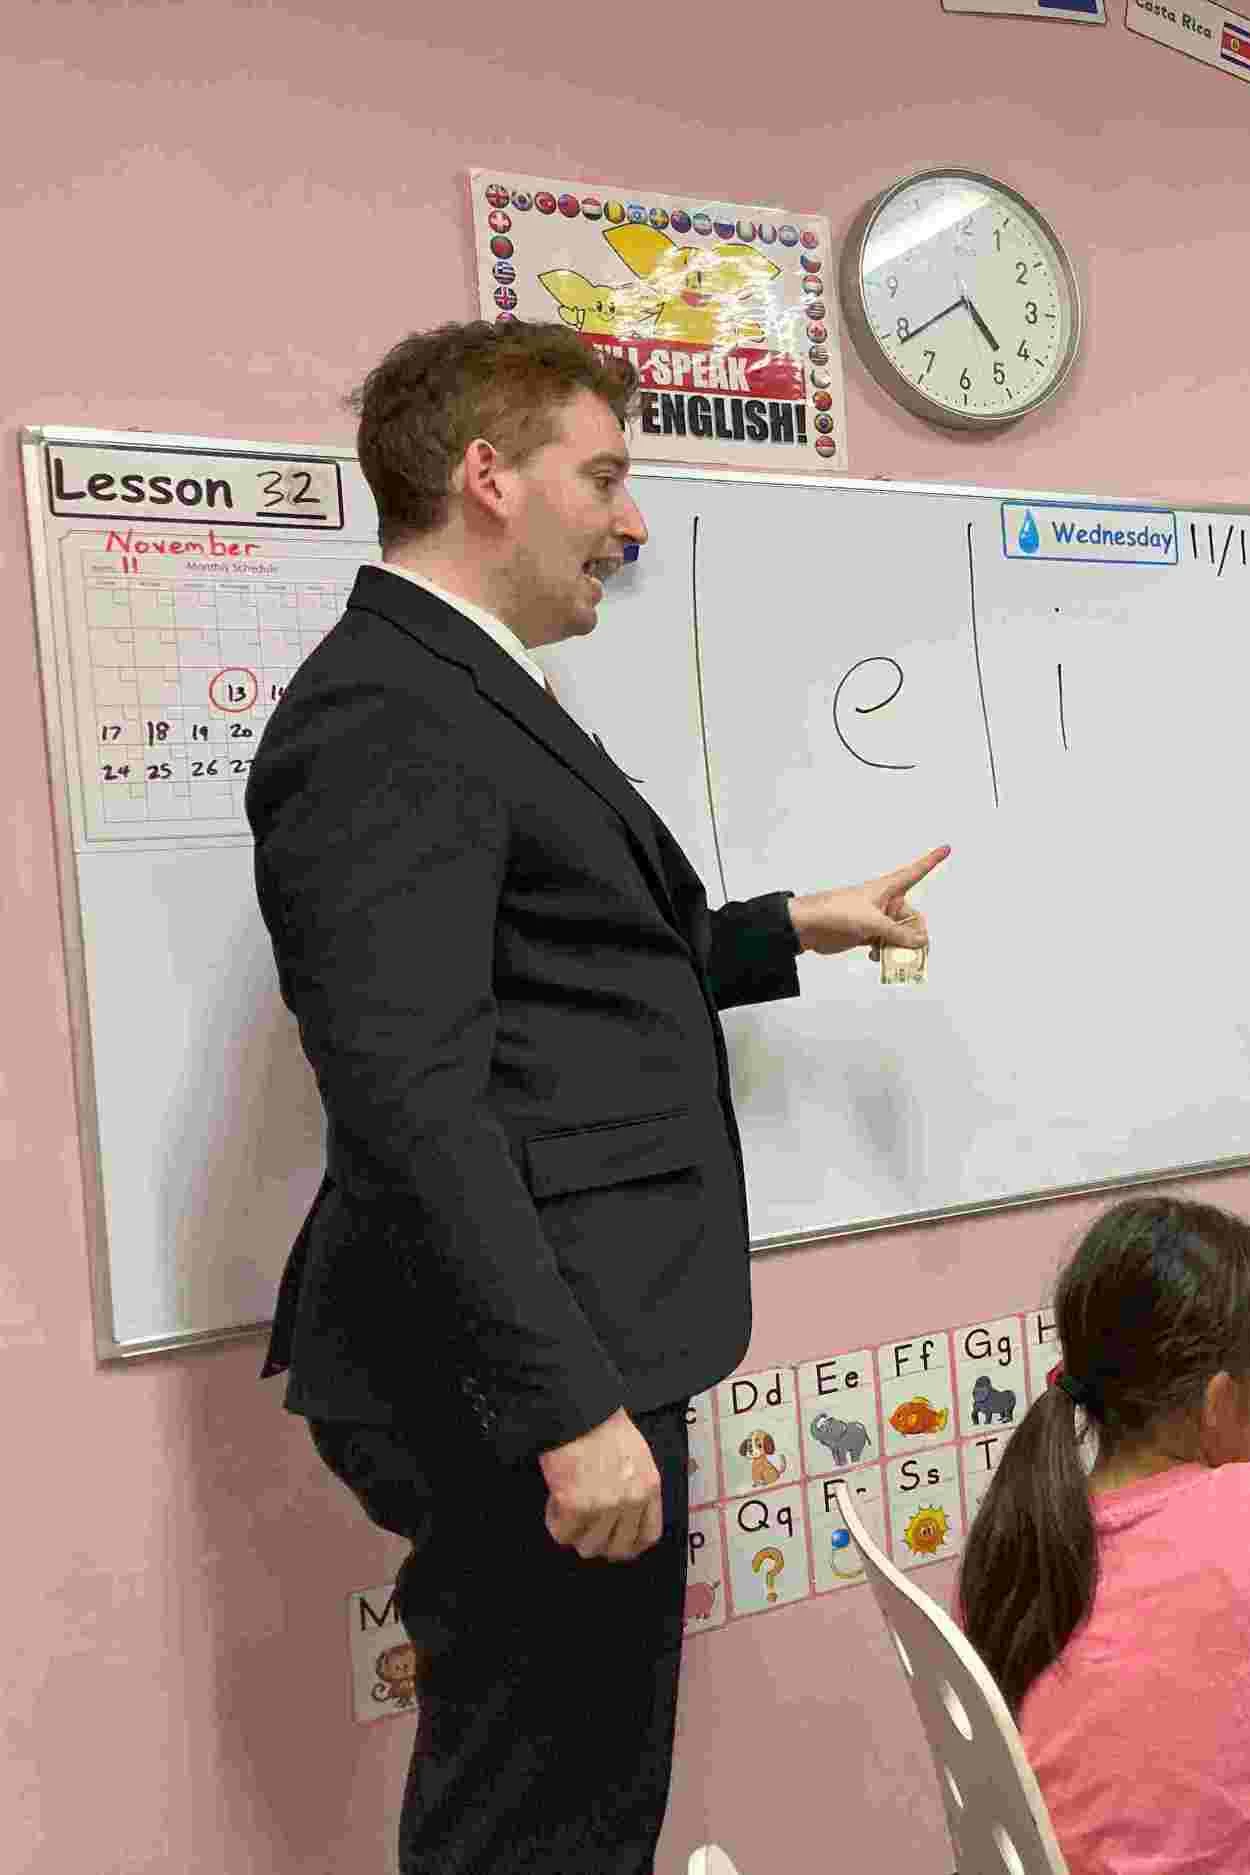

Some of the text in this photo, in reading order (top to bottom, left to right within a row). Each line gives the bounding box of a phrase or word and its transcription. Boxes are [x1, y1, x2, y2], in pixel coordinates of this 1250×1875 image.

[1182, 12, 1212, 39] Rica
[992, 228, 1001, 252] 1
[886, 274, 899, 298] 9
[1015, 261, 1028, 286] 2
[1024, 301, 1038, 325] 3
[896, 317, 911, 340] 8
[923, 350, 936, 374] 7
[1016, 339, 1030, 361] 4
[652, 348, 752, 392] SPEAK
[959, 367, 972, 391] 6
[992, 361, 1006, 386] 5
[641, 390, 808, 444] ENGLISH!
[54, 457, 321, 508] Lesson 32
[105, 528, 262, 557] November
[1051, 521, 1174, 555] Wednesday
[121, 556, 140, 574] 11
[227, 683, 247, 703] 13
[101, 720, 254, 747] 17 18 19 20
[101, 764, 131, 781] 24
[147, 762, 173, 780] 25
[191, 759, 219, 776] 26
[894, 1339, 935, 1378] Ff
[964, 1327, 1013, 1367] Gg
[815, 1360, 860, 1396] Ee
[731, 1372, 782, 1415] Dd
[899, 1460, 941, 1492] Ss
[736, 1499, 794, 1538] Qq
